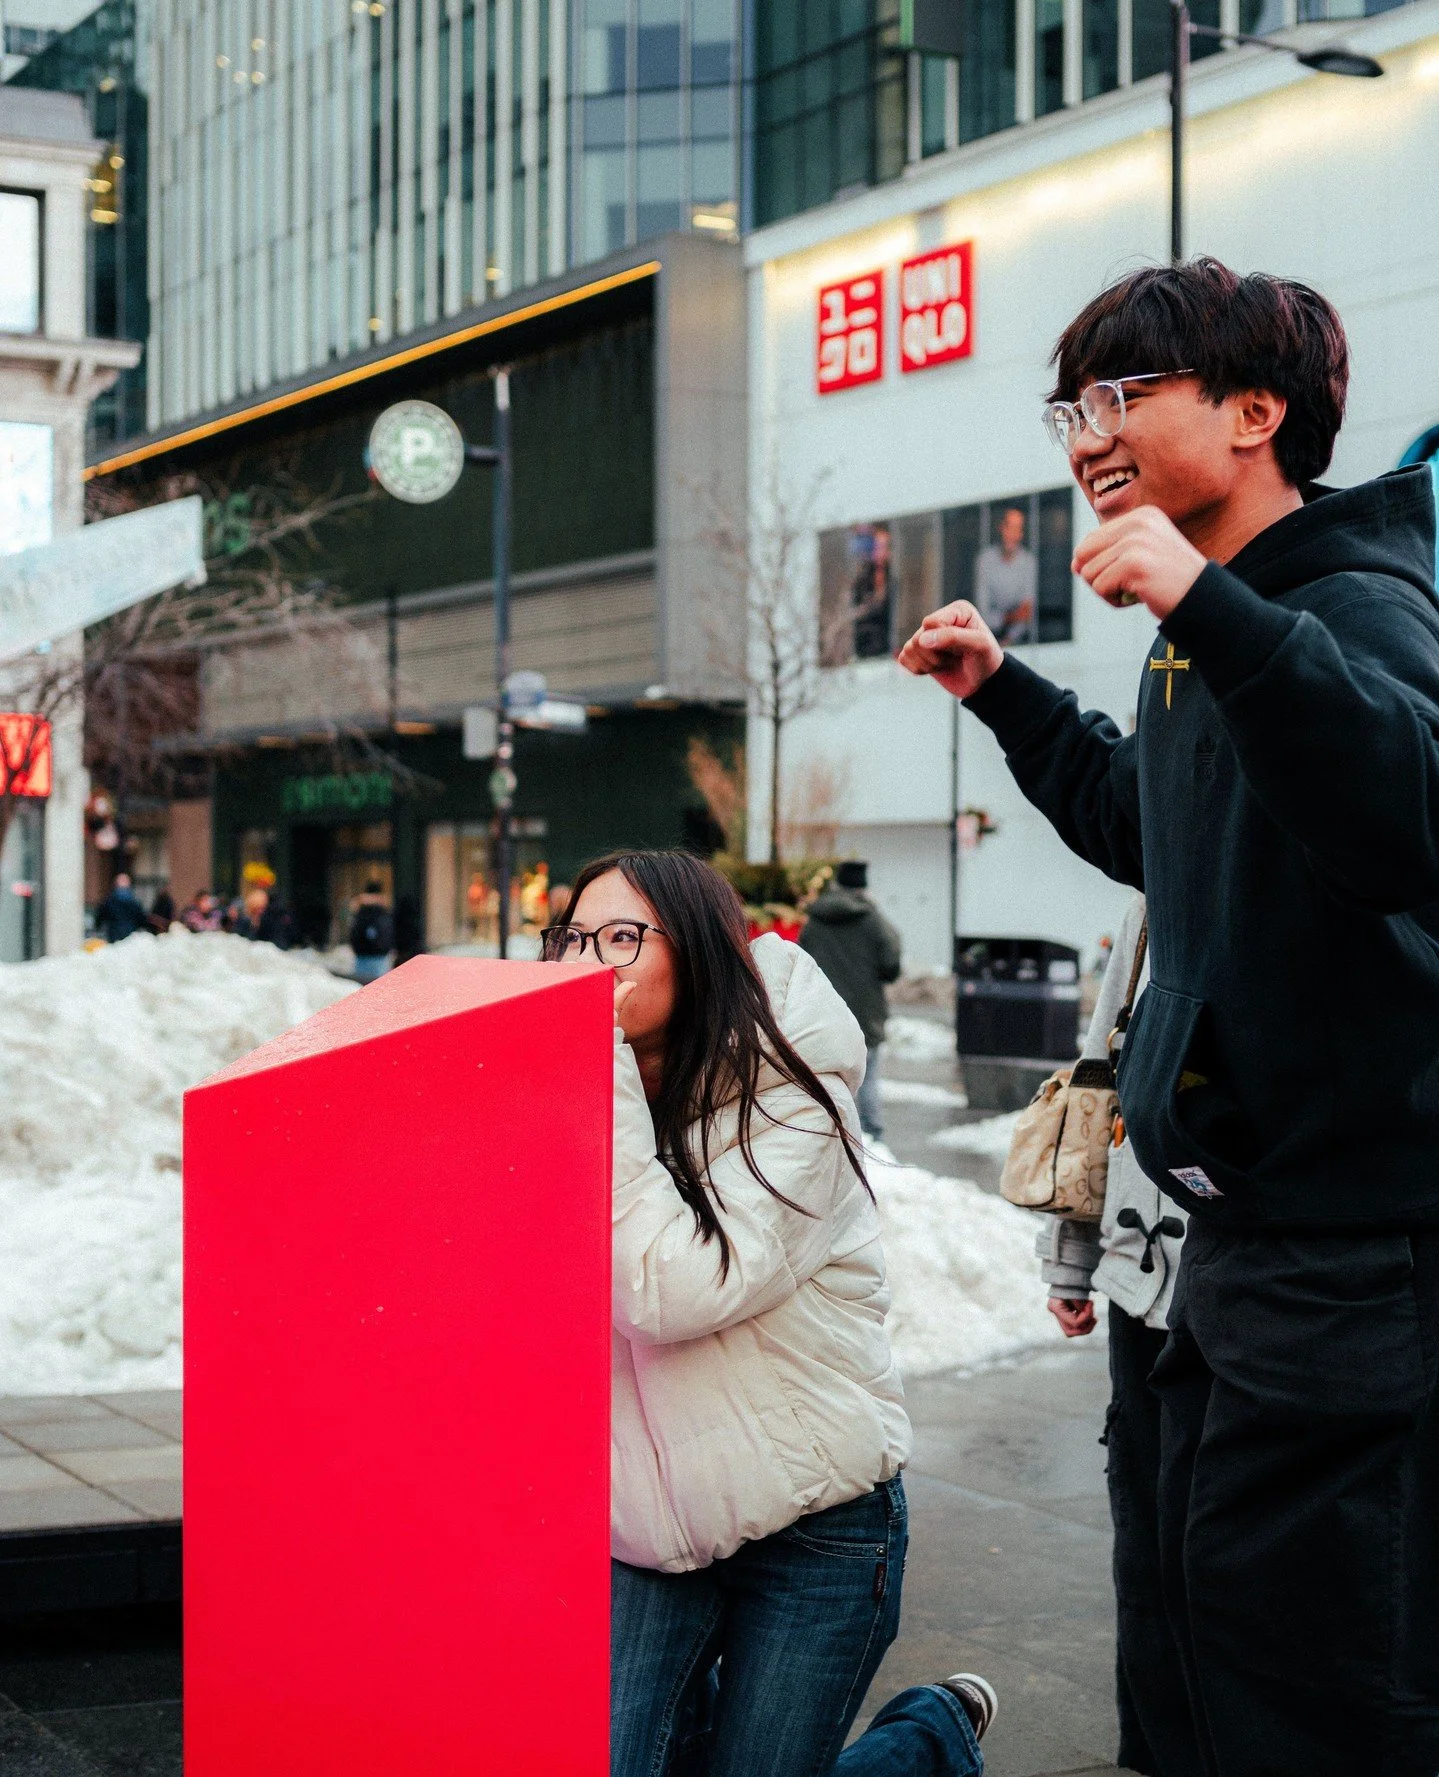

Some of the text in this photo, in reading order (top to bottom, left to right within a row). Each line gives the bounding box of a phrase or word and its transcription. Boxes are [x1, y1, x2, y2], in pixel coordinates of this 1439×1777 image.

[902, 253, 962, 311] UNI
[902, 300, 966, 365] QLO
[400, 426, 435, 472] P
